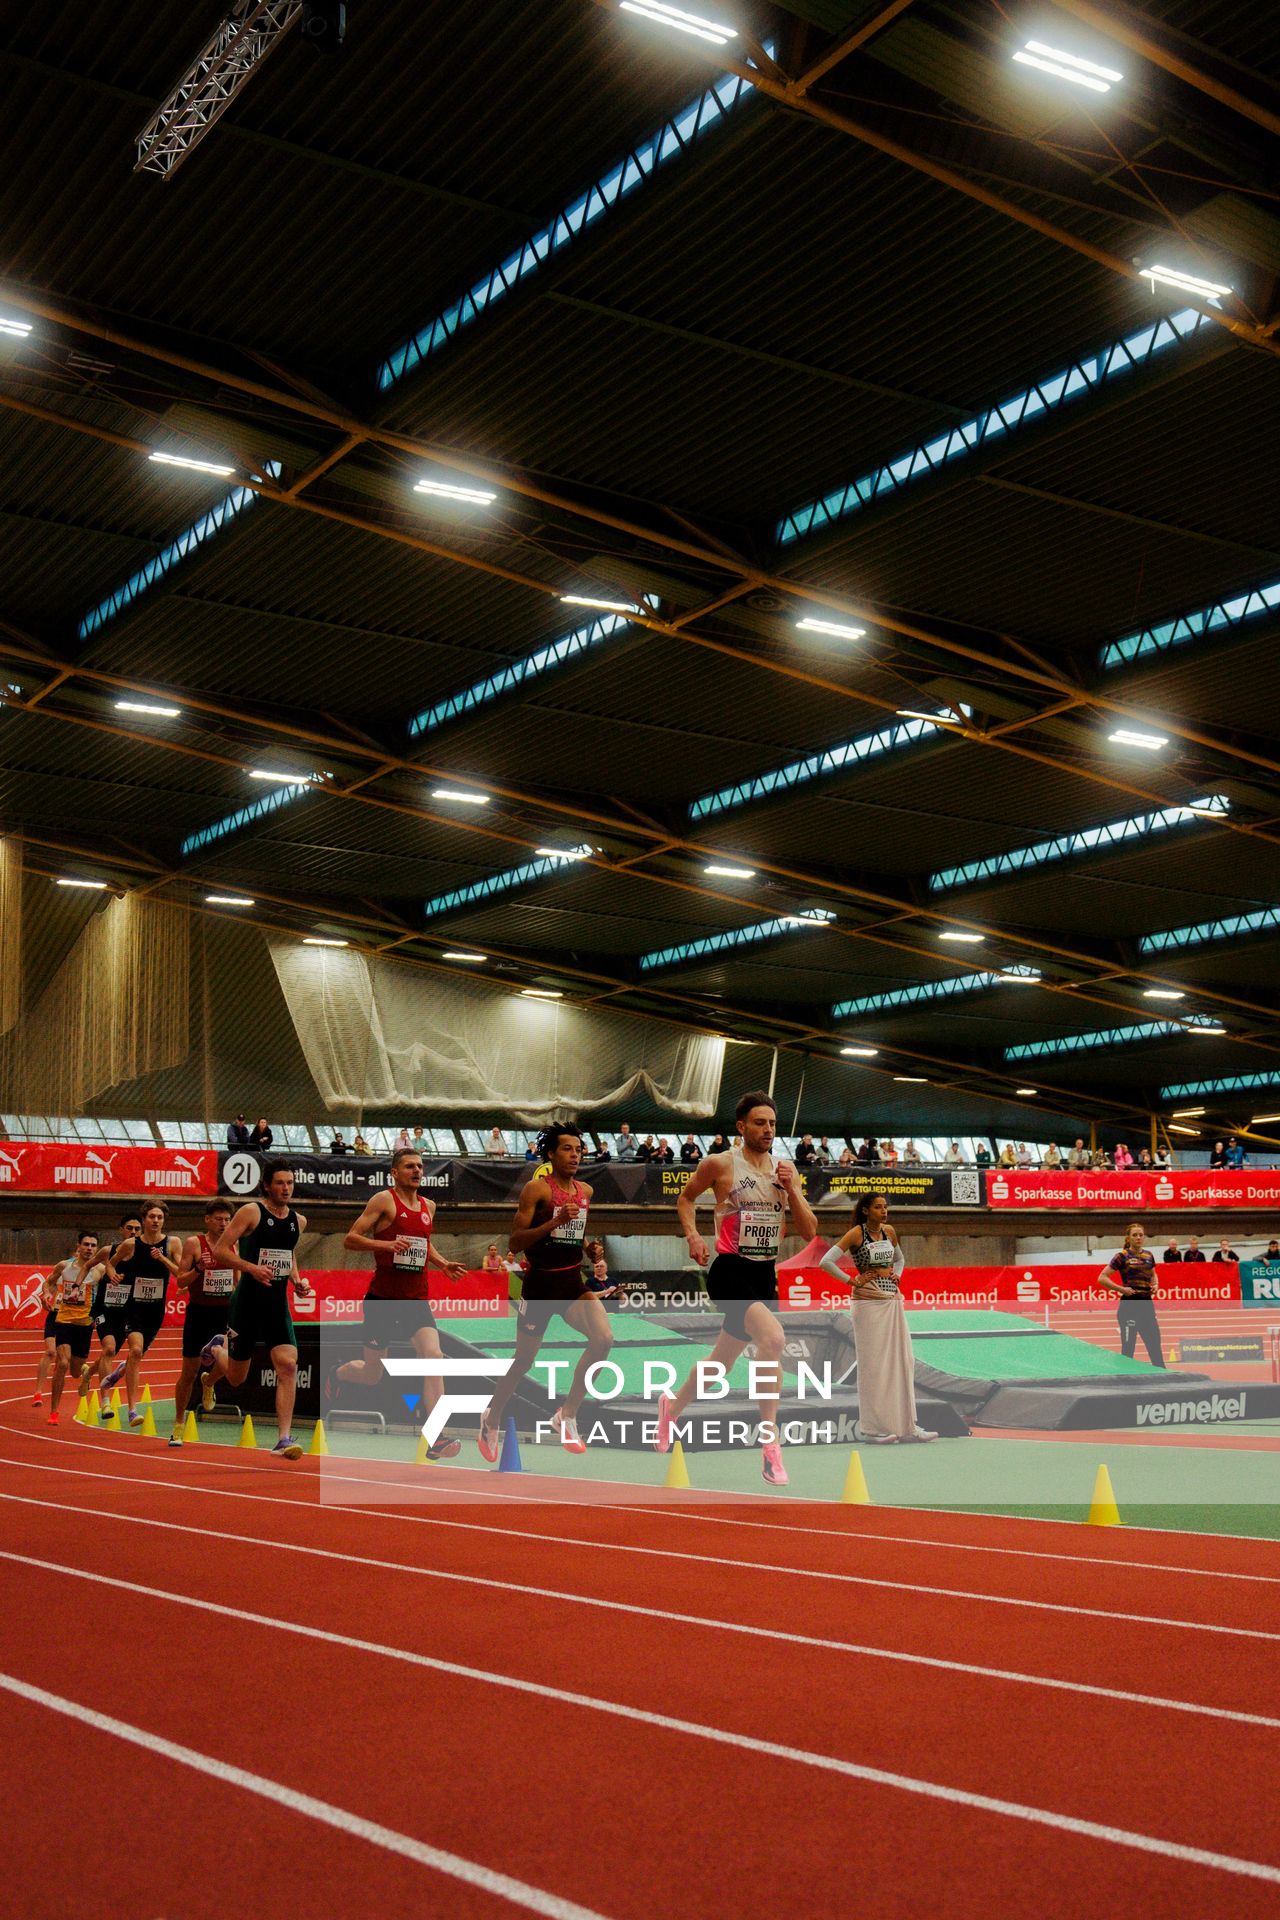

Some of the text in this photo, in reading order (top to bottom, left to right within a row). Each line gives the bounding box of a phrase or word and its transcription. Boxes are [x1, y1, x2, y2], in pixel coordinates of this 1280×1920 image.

[54, 1167, 105, 1185] PUMA
[145, 1169, 192, 1188] PUMA
[232, 1163, 251, 1184] 21
[295, 1169, 315, 1184] the
[318, 1170, 353, 1185] world
[368, 1171, 384, 1187] all
[420, 1173, 449, 1188] ame!
[829, 1177, 933, 1186] JETZT QR-CODE SCANNEN
[662, 1186, 680, 1195] Ihre
[848, 1186, 886, 1194] MITGLIED
[887, 1186, 925, 1194] WERDEN!
[1014, 1187, 1142, 1201] Sparkasse Dortmund
[1180, 1186, 1242, 1202] Sparkasse
[564, 1230, 576, 1239] 198
[744, 1225, 779, 1238] PROBST
[756, 1237, 770, 1247] 146
[260, 1259, 291, 1270] McCANN
[409, 1256, 417, 1265] 75
[141, 1286, 156, 1295] TENT
[205, 1278, 232, 1287] SCHRICK
[660, 1291, 711, 1308] TOUR
[913, 1289, 997, 1305] Dortmund
[1050, 1286, 1121, 1305] Sparkass
[1157, 1283, 1231, 1300] ortmund
[429, 1294, 500, 1312] ortmund
[261, 1364, 312, 1389] venkel
[1136, 1391, 1246, 1425] vennekel
